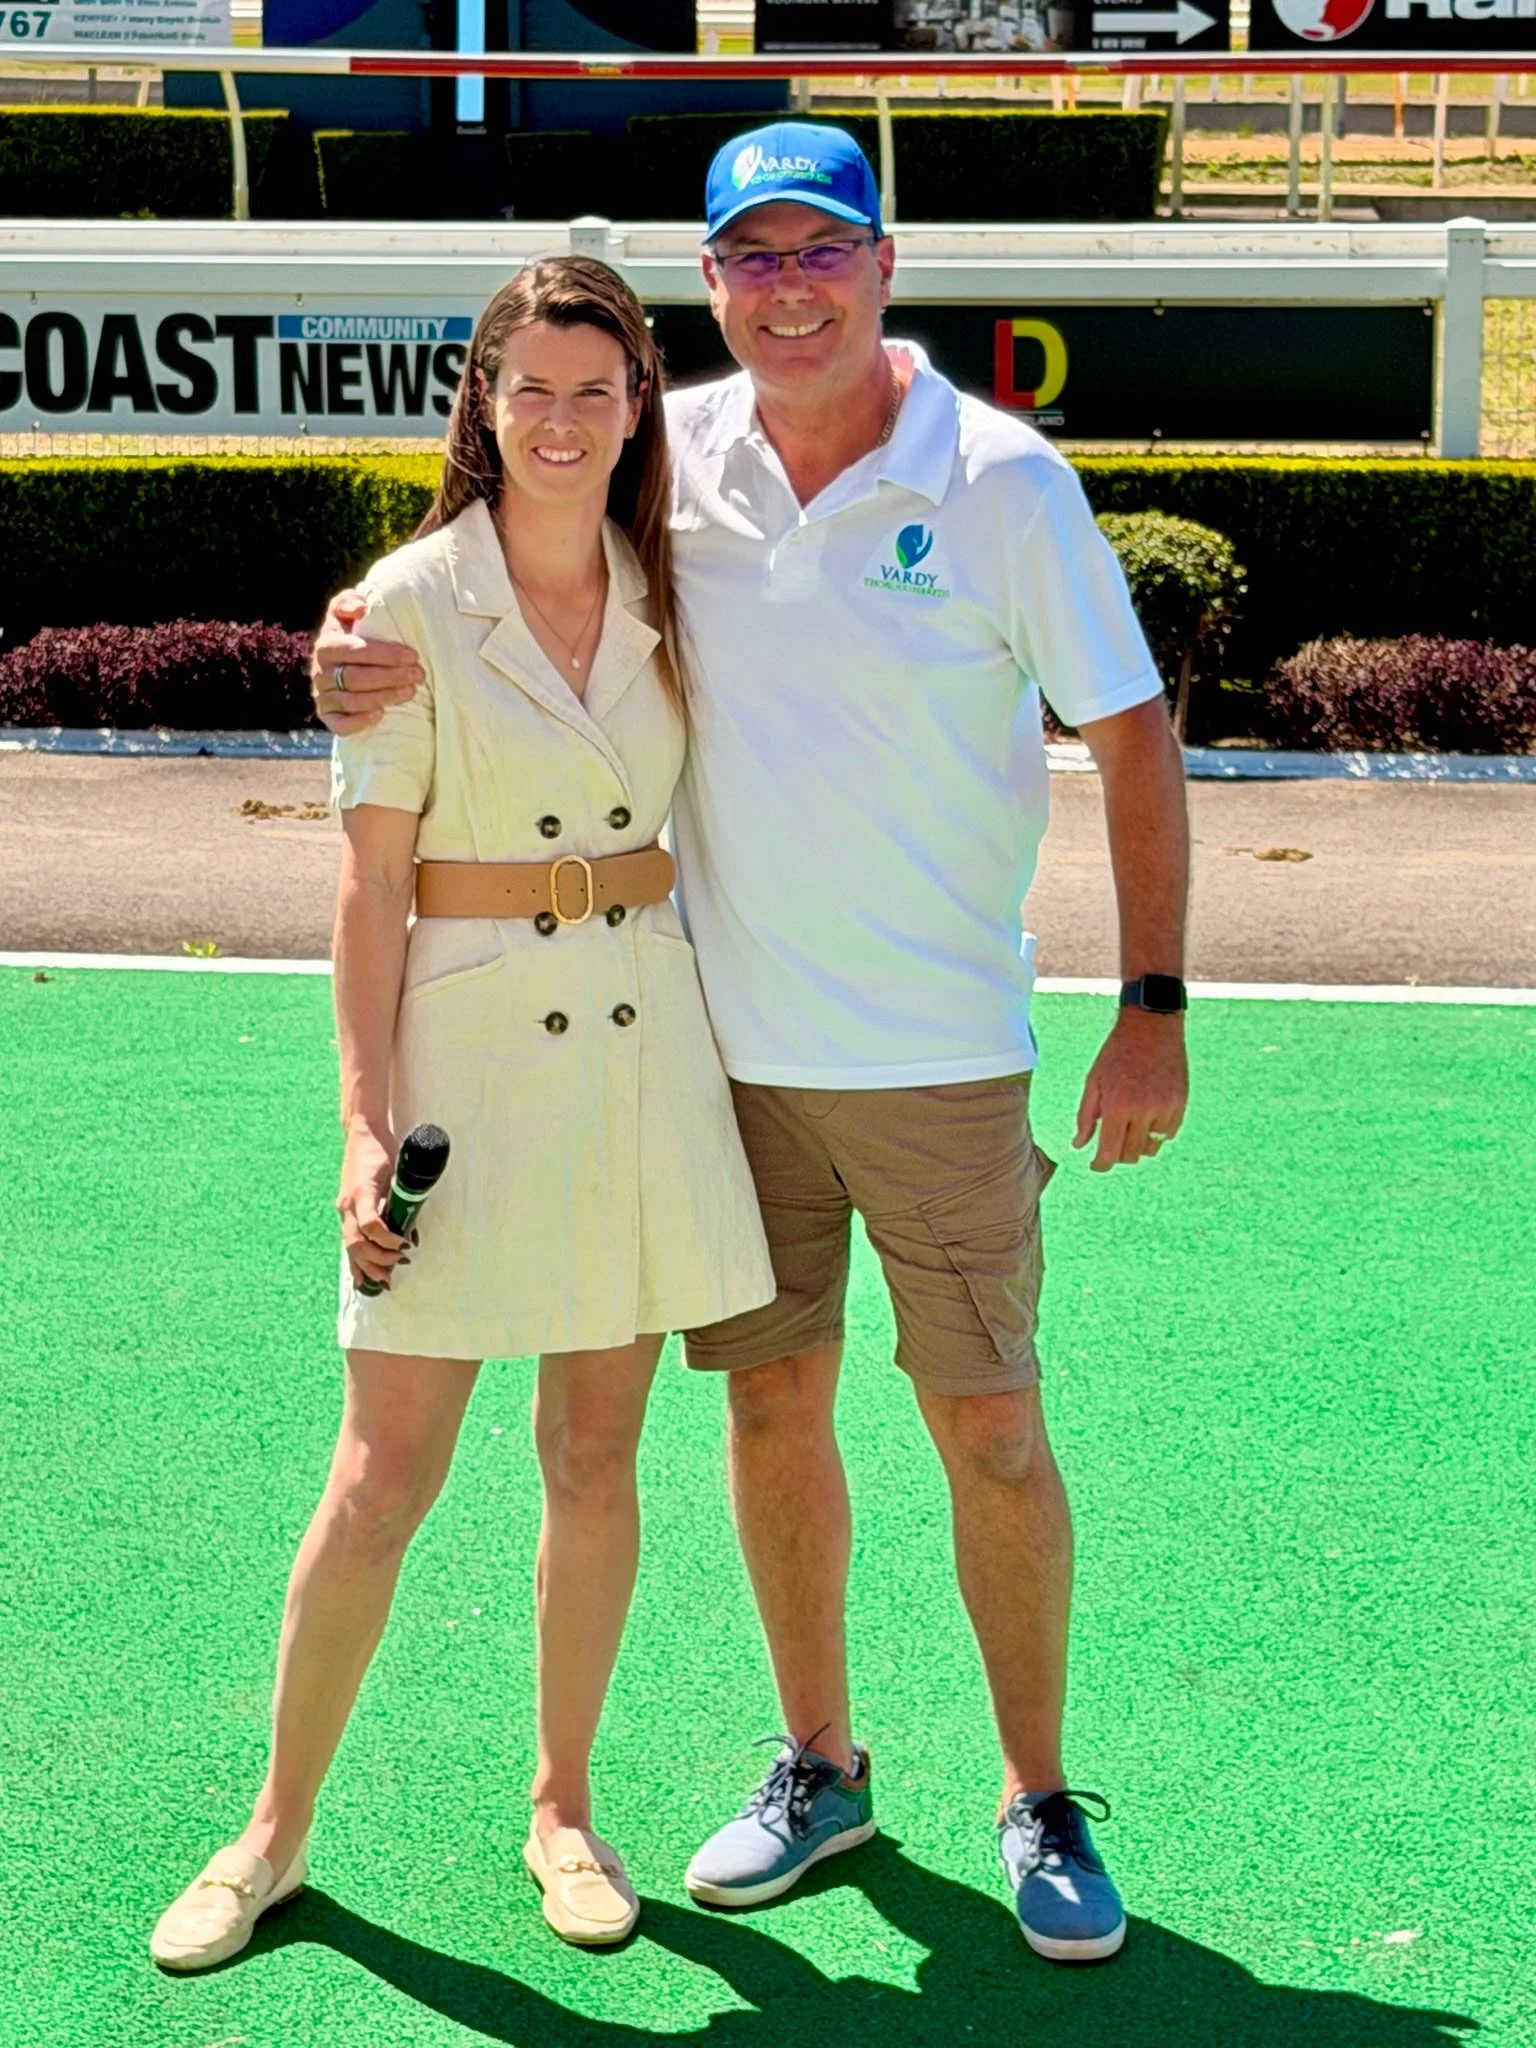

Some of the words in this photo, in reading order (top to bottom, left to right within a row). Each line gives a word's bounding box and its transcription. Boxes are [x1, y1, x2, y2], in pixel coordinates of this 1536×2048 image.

[760, 156, 820, 173] VARDY
[301, 316, 448, 340] COMMUNITY
[280, 343, 467, 418] NEWS
[880, 564, 938, 588] VARDY
